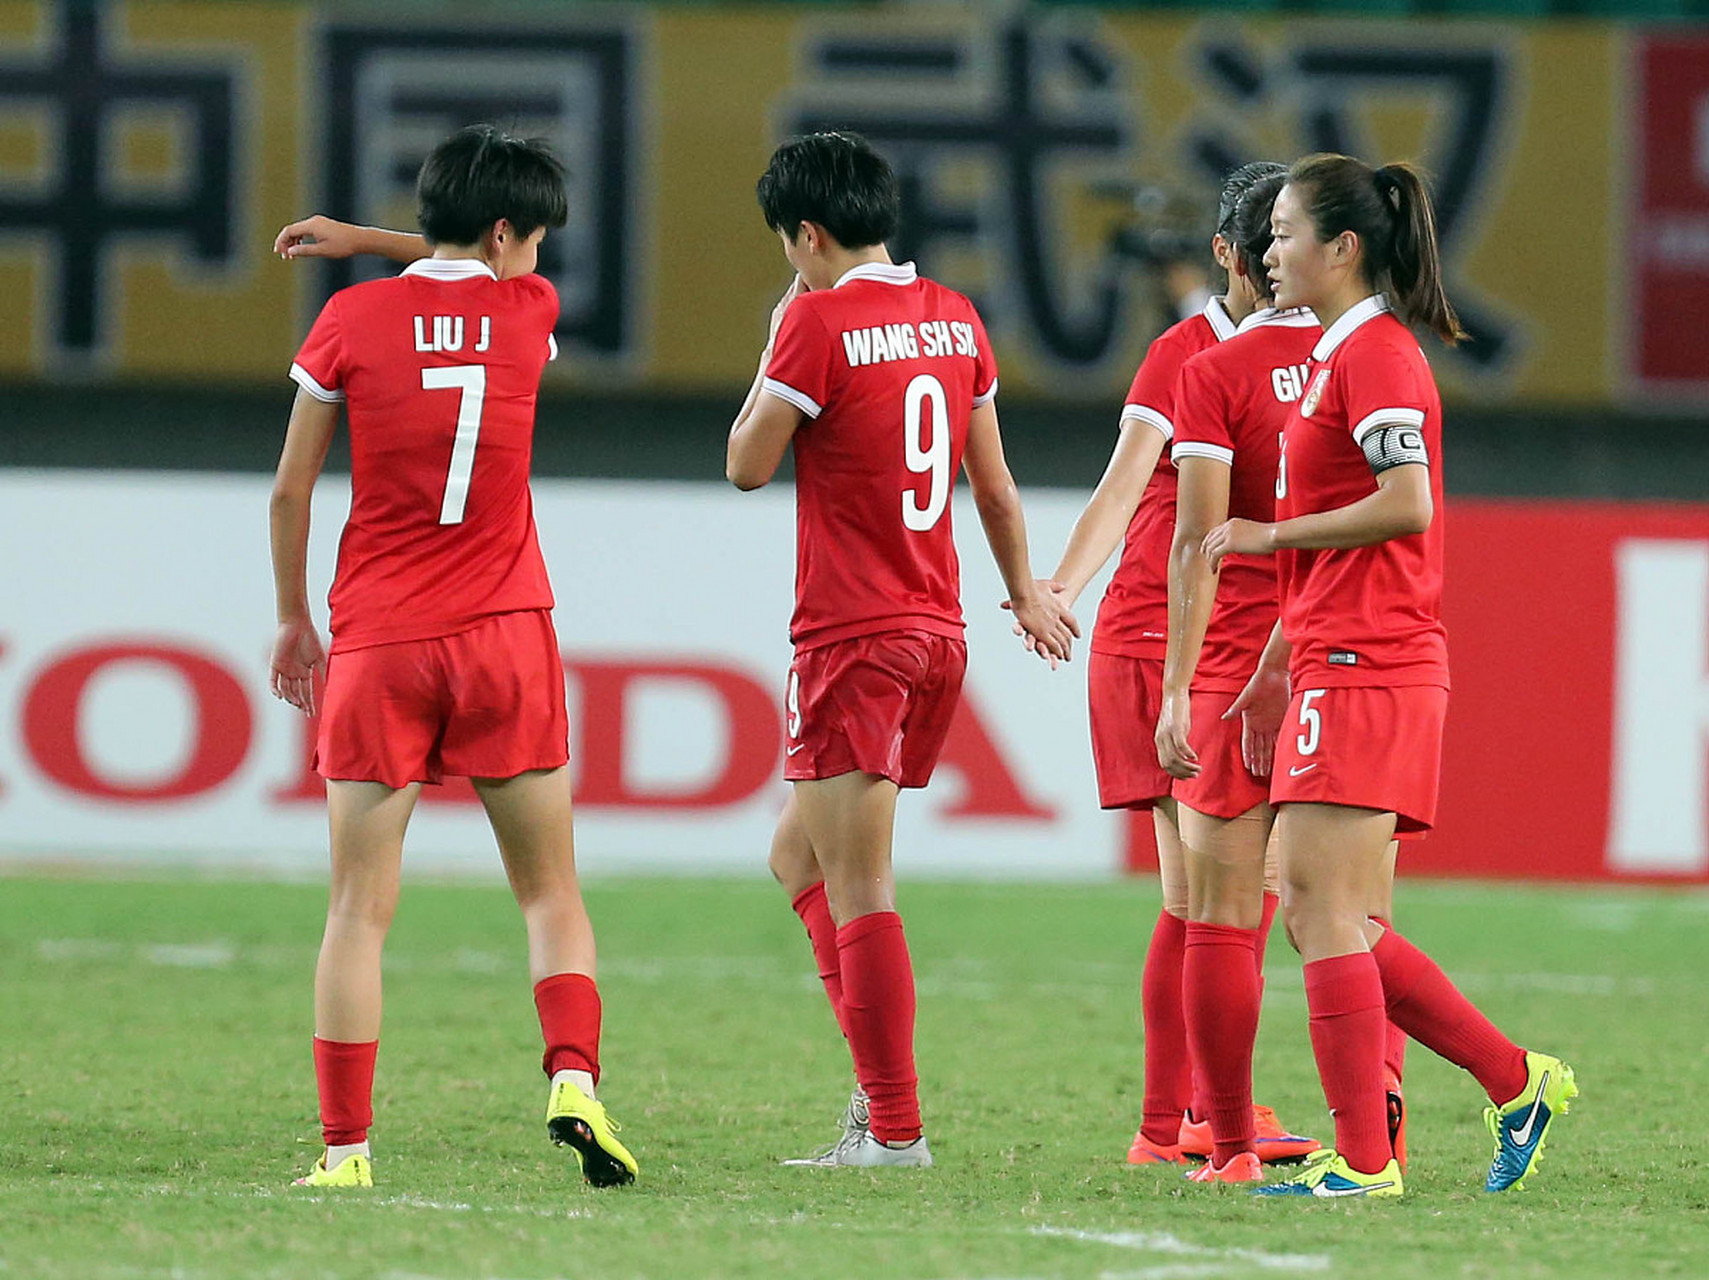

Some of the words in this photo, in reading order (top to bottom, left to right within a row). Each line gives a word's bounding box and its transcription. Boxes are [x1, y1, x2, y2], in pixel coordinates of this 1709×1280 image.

[413, 315, 465, 352] LIU
[474, 315, 491, 352] J
[841, 323, 919, 367] WANG
[919, 320, 953, 357] SH
[421, 364, 486, 525] 7
[902, 374, 950, 531] 9
[0, 636, 1057, 822] ODA
[1297, 688, 1326, 756] 5
